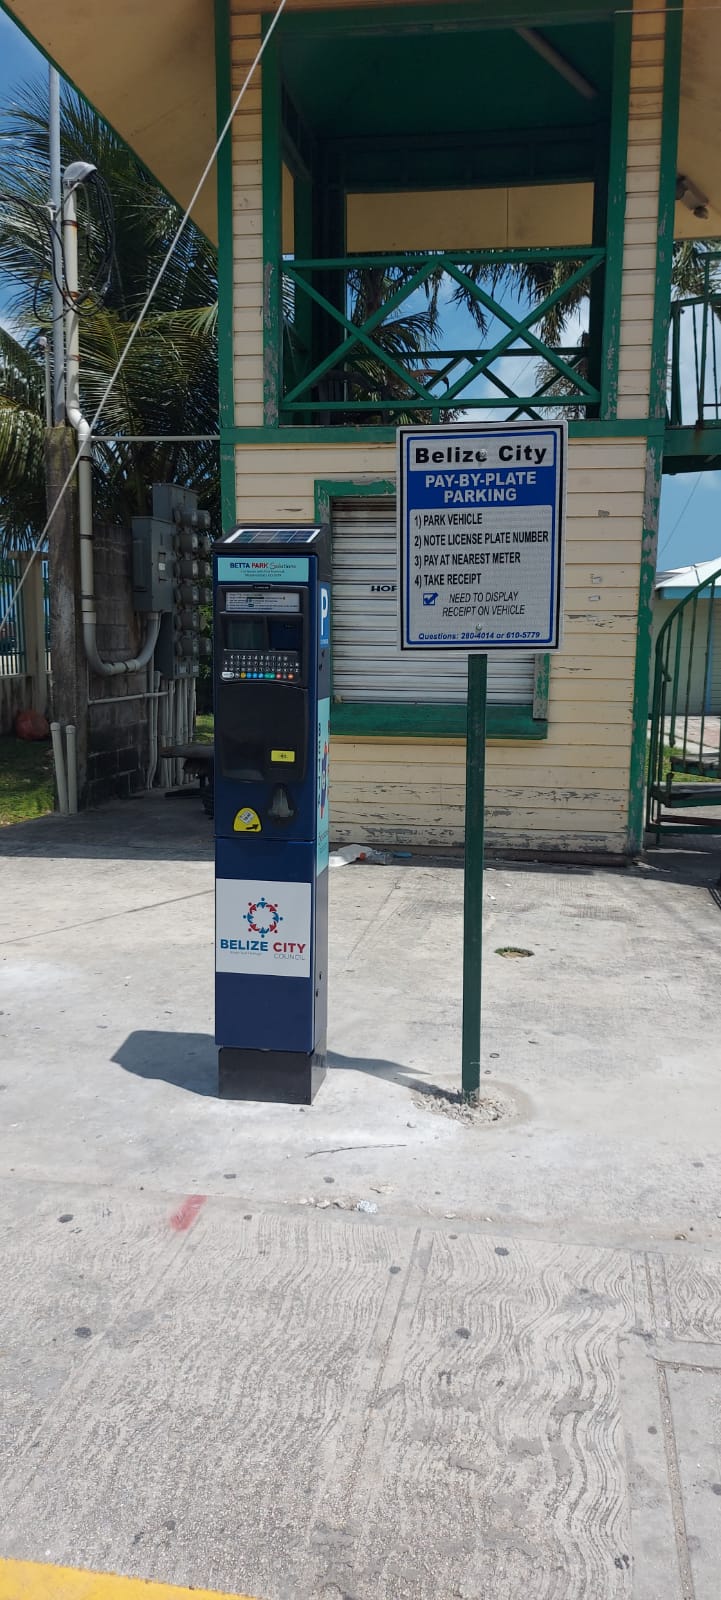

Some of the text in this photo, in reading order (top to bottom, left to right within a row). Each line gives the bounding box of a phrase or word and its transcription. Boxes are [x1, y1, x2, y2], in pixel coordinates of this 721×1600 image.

[415, 445, 547, 464] Belize City
[425, 471, 537, 488] PAY-BY-PLATE
[444, 488, 517, 503] PARKING
[414, 513, 483, 529] 1) PARK VEHICLE
[414, 530, 549, 549] 2) NOTE LICENSE PLATE NUMBER
[414, 552, 521, 569] 3) PAY AT NEAREST METER
[414, 573, 482, 588] 4) TAKE RECEIPT
[449, 592, 519, 603] NEED TO DISPLAY
[321, 588, 328, 636] P
[442, 605, 526, 617] RECEIPT ON VEHICLE
[220, 939, 306, 954] BELIZE CITY
[273, 953, 306, 961] COUNCIL
